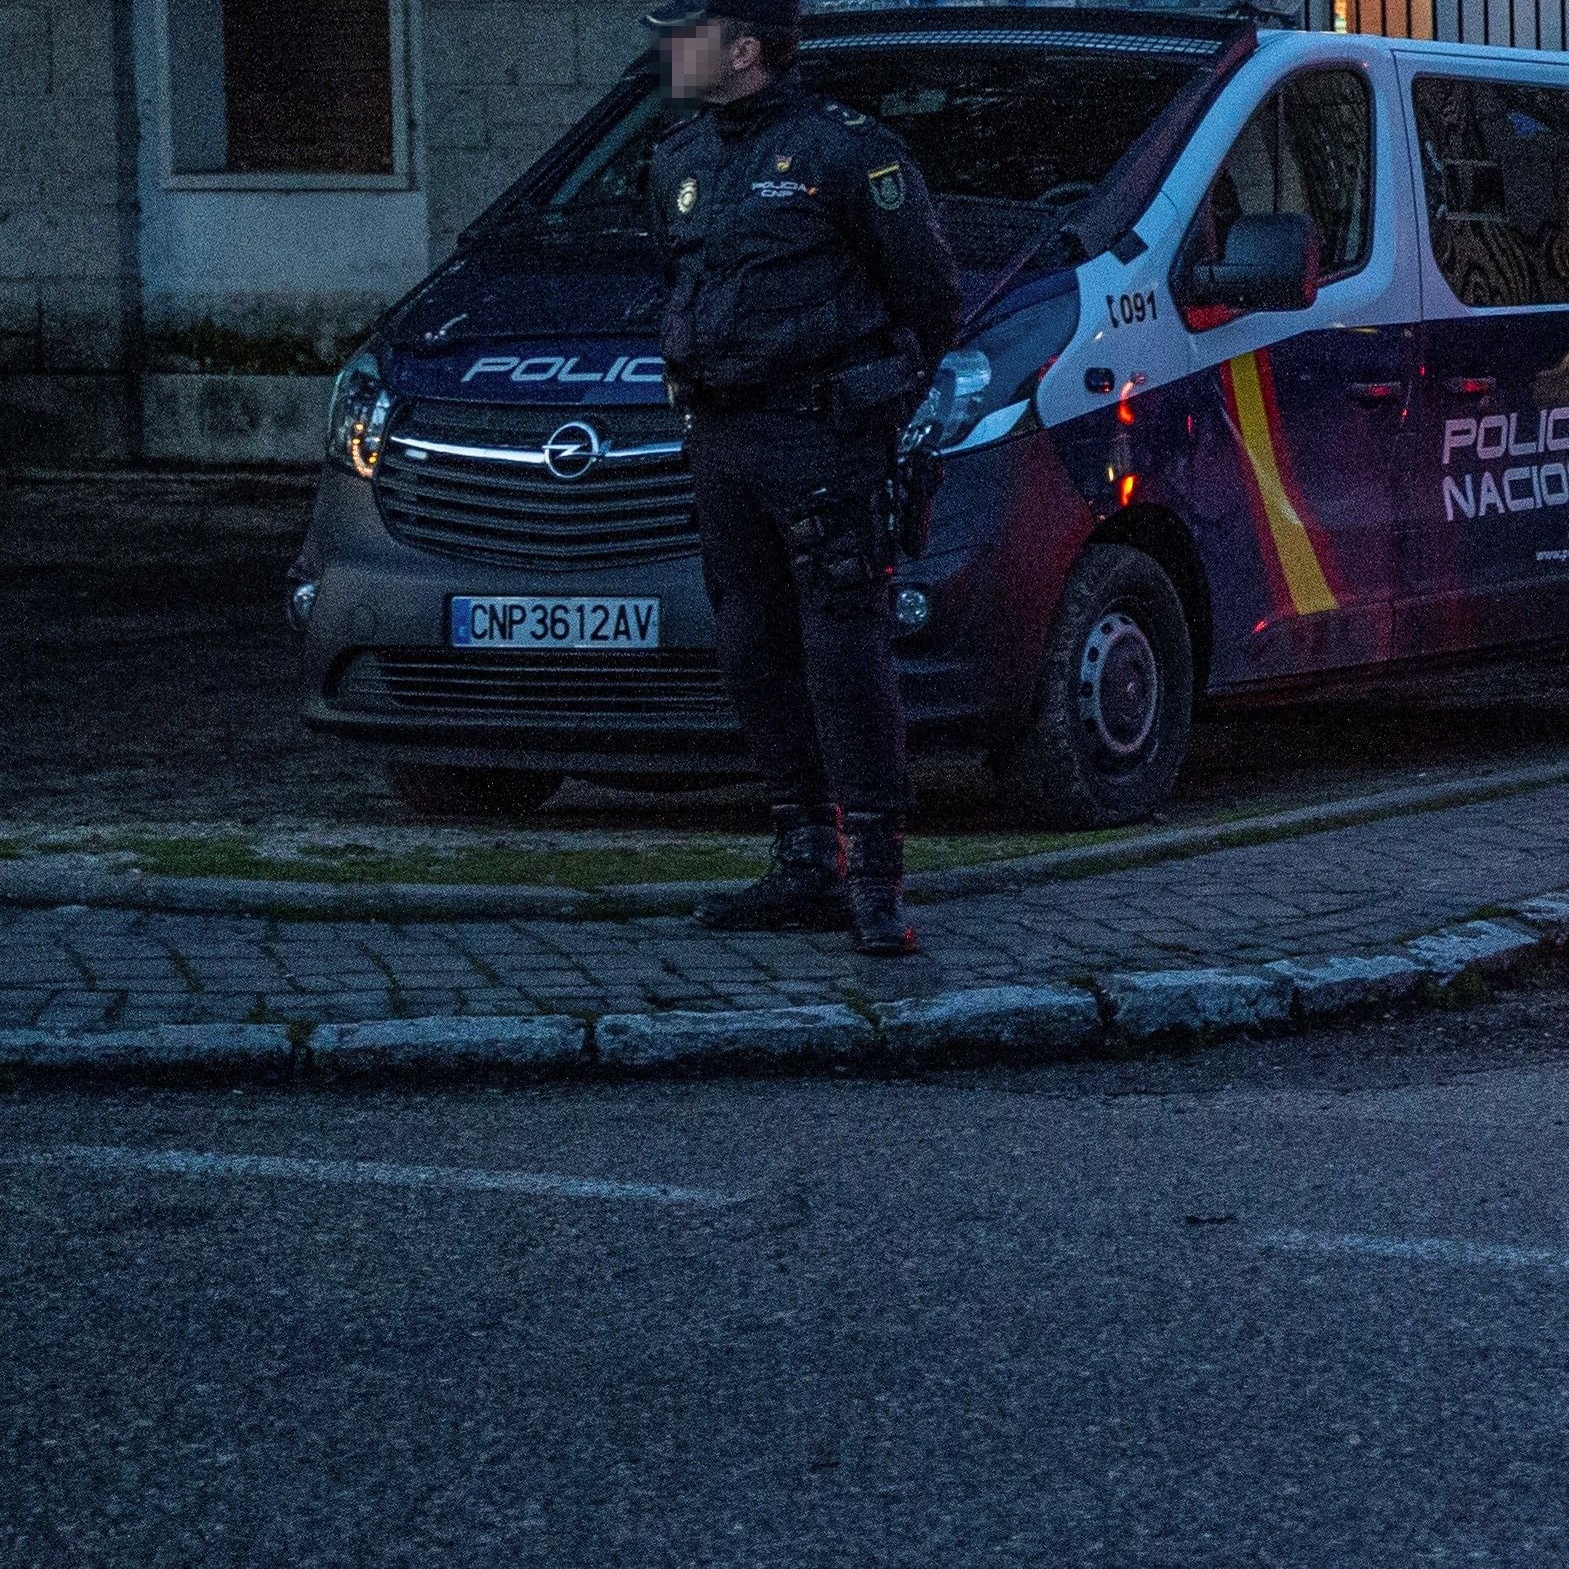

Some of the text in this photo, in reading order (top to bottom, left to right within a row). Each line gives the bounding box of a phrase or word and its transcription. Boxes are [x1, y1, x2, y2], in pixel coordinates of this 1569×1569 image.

[1120, 291, 1158, 324] 091
[461, 356, 666, 382] POLIC
[470, 603, 654, 642] CNP3612AV
